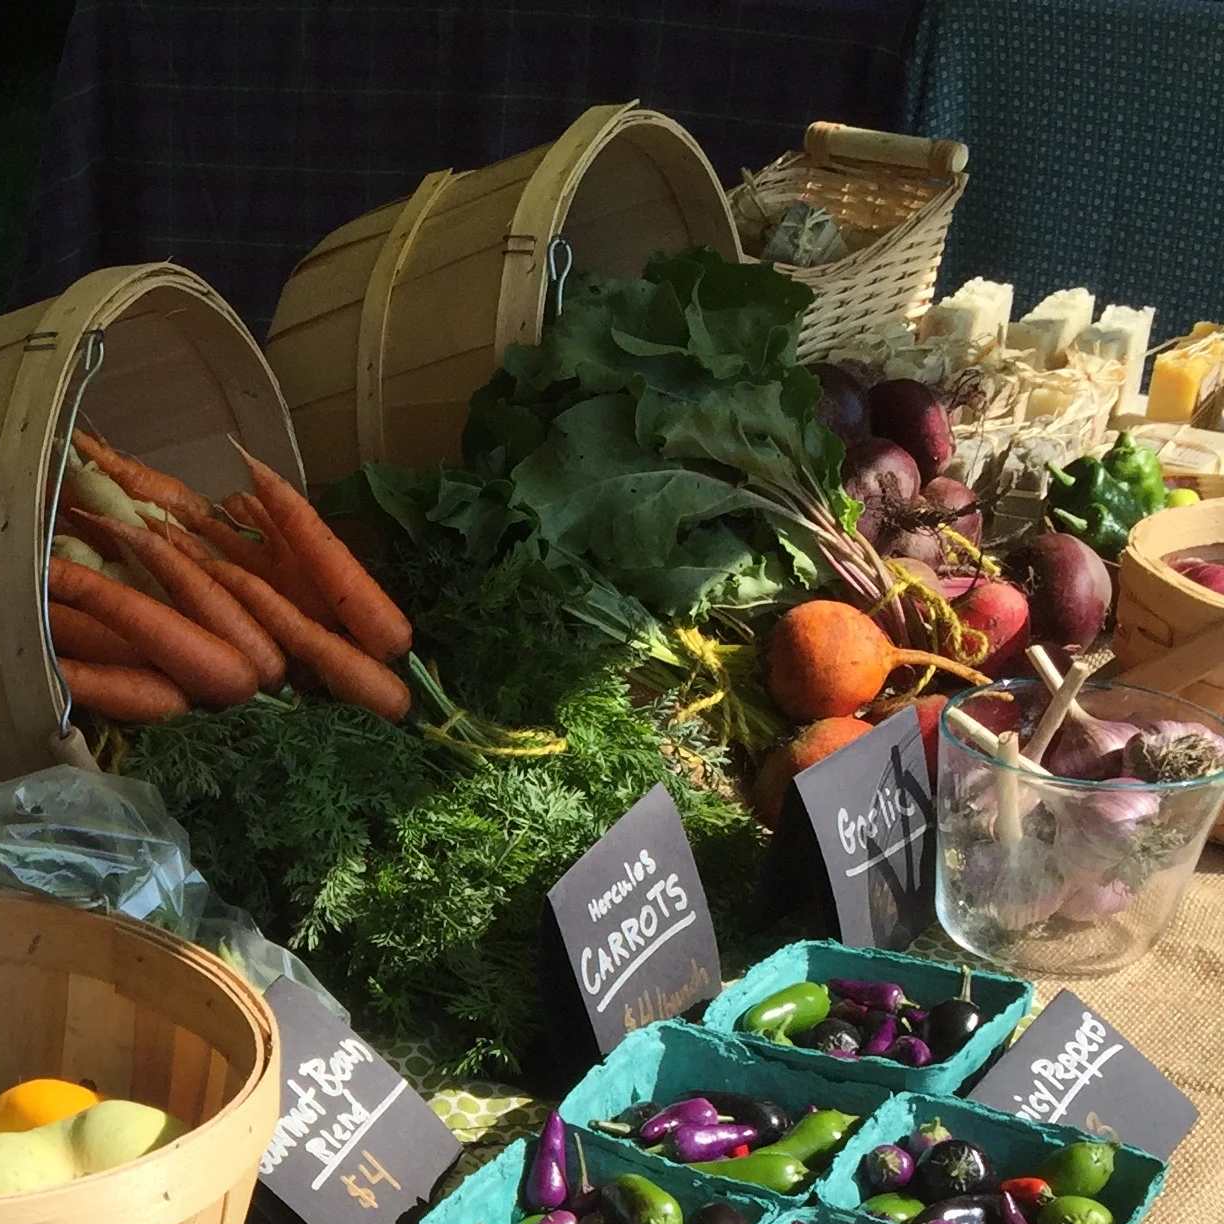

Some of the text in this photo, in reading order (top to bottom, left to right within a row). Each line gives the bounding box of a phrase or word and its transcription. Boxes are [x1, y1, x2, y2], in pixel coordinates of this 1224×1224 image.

[837, 787, 915, 855] Garlic
[587, 849, 656, 923] Hercules
[581, 873, 688, 995] CARROTS
[298, 1038, 374, 1097] Bean
[1014, 1079, 1067, 1122] icy
[305, 1089, 373, 1165] Blend
[340, 1149, 402, 1209] $4
